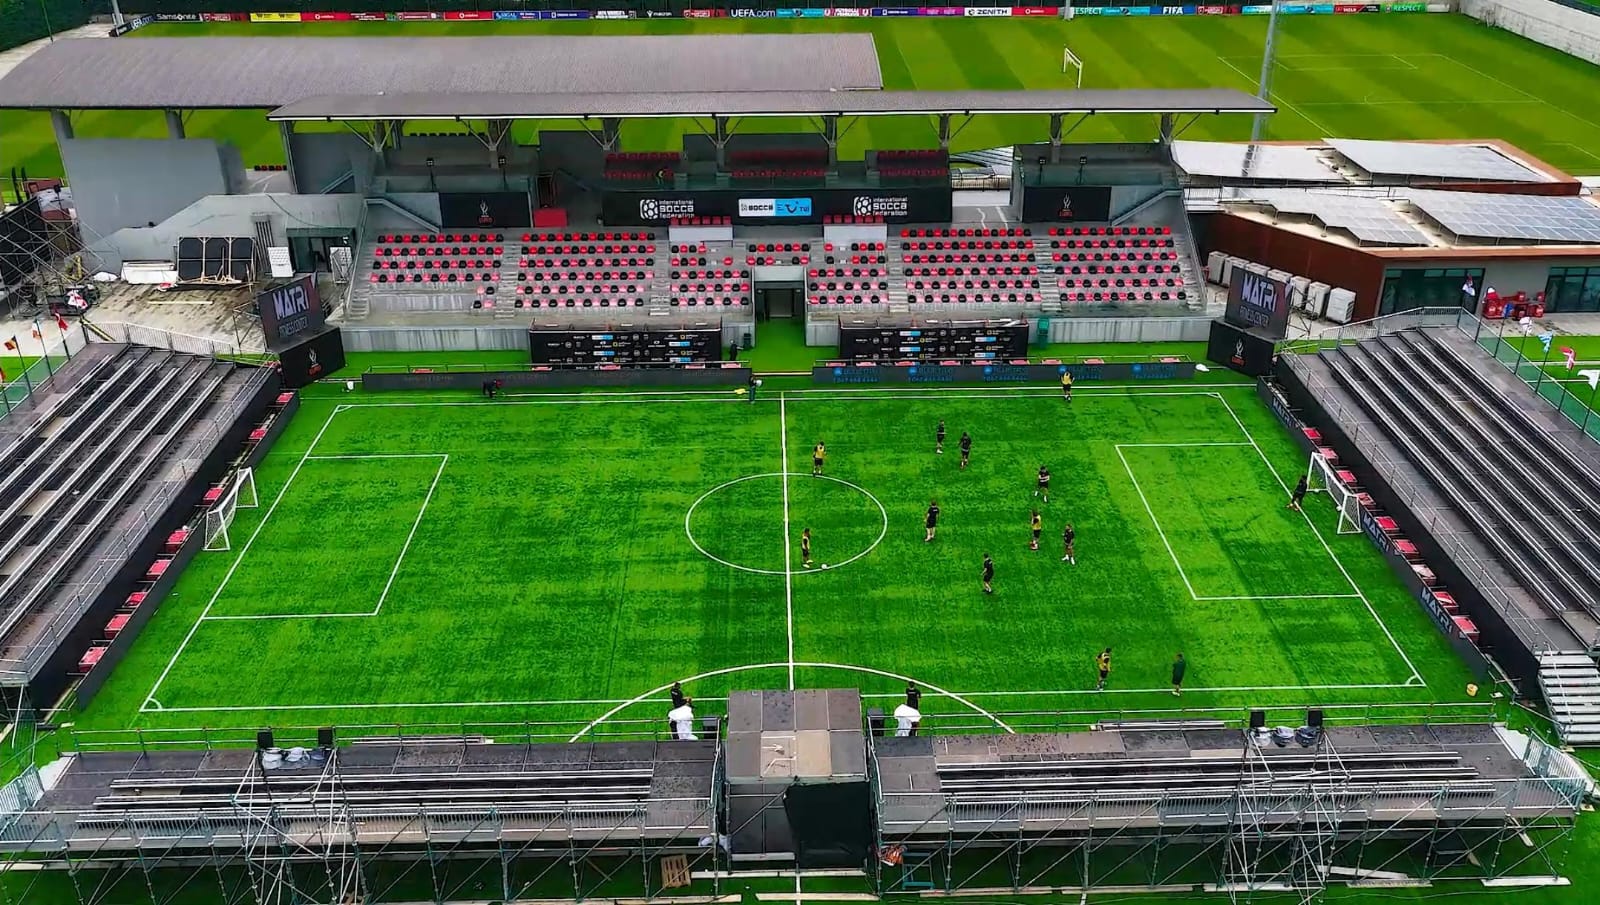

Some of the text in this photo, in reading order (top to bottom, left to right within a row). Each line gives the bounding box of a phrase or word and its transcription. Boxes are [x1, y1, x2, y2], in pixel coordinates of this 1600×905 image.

[730, 9, 776, 18] UEFA.com
[1075, 7, 1103, 15] ESPECT
[1162, 6, 1184, 15] FIFA
[156, 13, 197, 21] Samsonite
